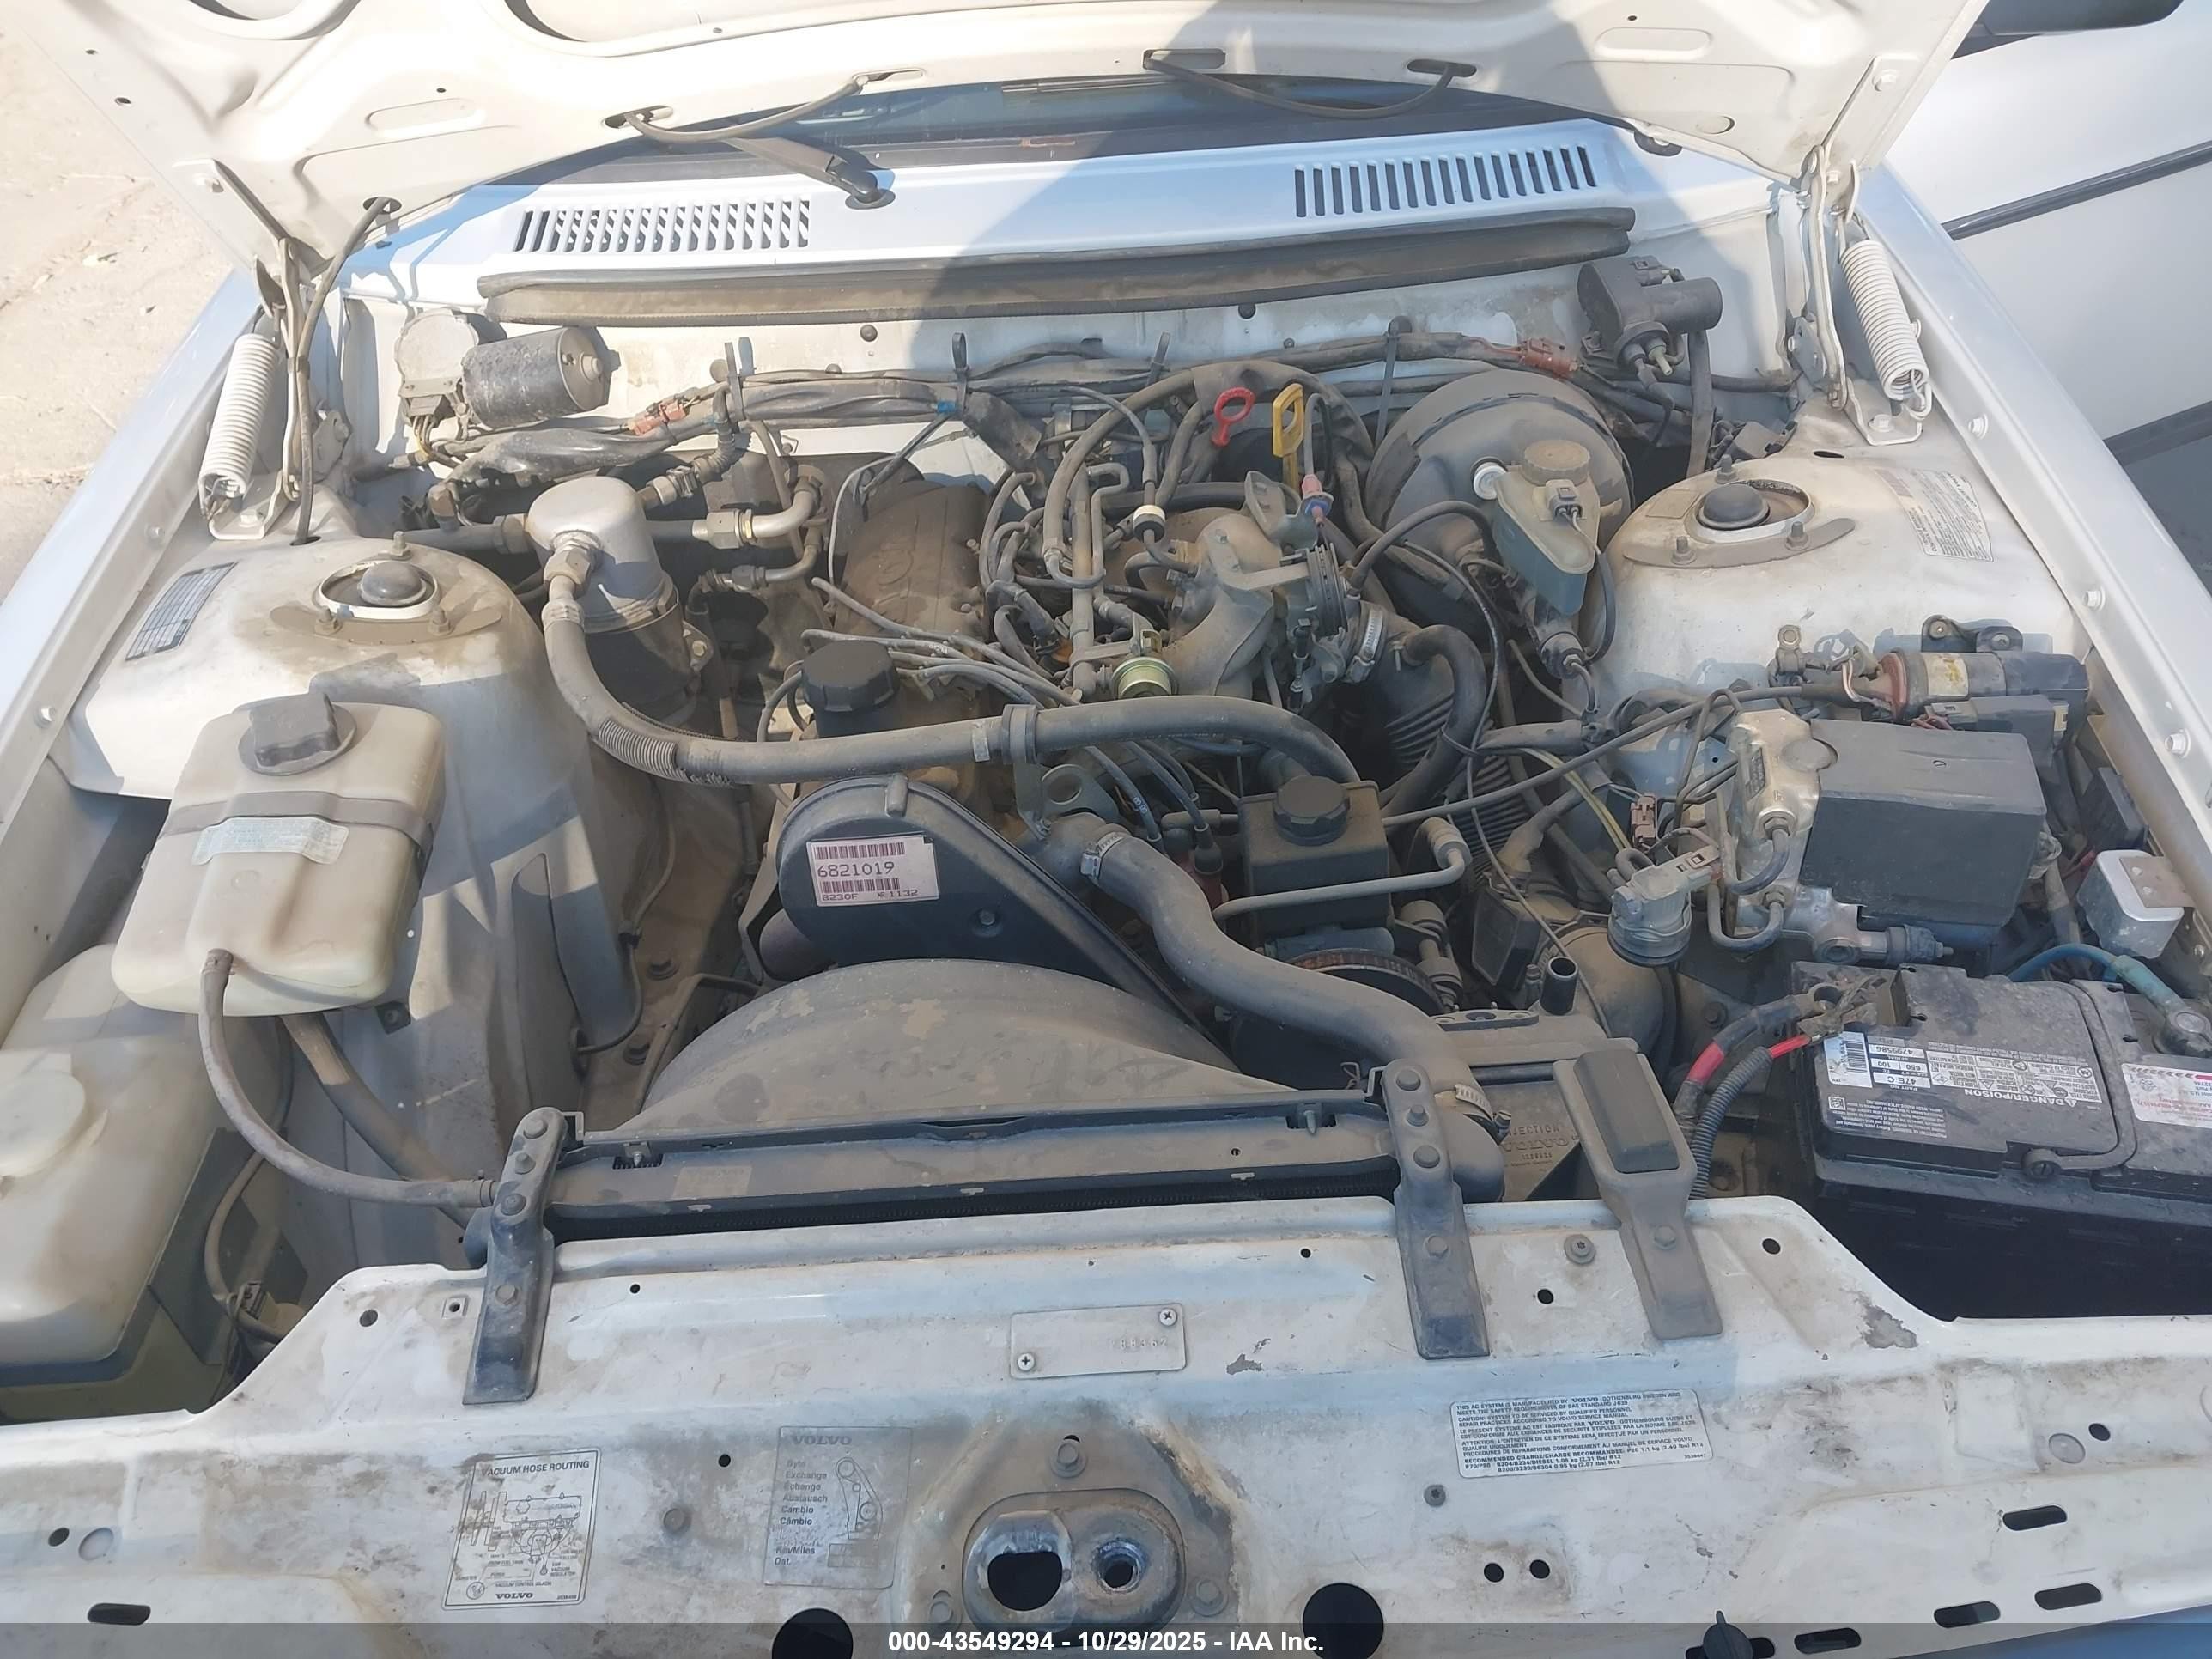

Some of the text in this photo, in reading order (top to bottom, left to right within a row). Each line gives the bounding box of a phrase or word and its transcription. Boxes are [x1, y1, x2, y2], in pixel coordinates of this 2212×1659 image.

[817, 861, 895, 878] 6821019
[1887, 1074, 1917, 1085] 47E-C
[1964, 1089, 2067, 1104] DANGER/POISON
[1510, 1123, 1560, 1136] JECTION
[791, 1436, 853, 1445] VOLVO
[482, 1461, 590, 1476] VACUUM HOSE ROUTING
[781, 1506, 814, 1515] Cambio
